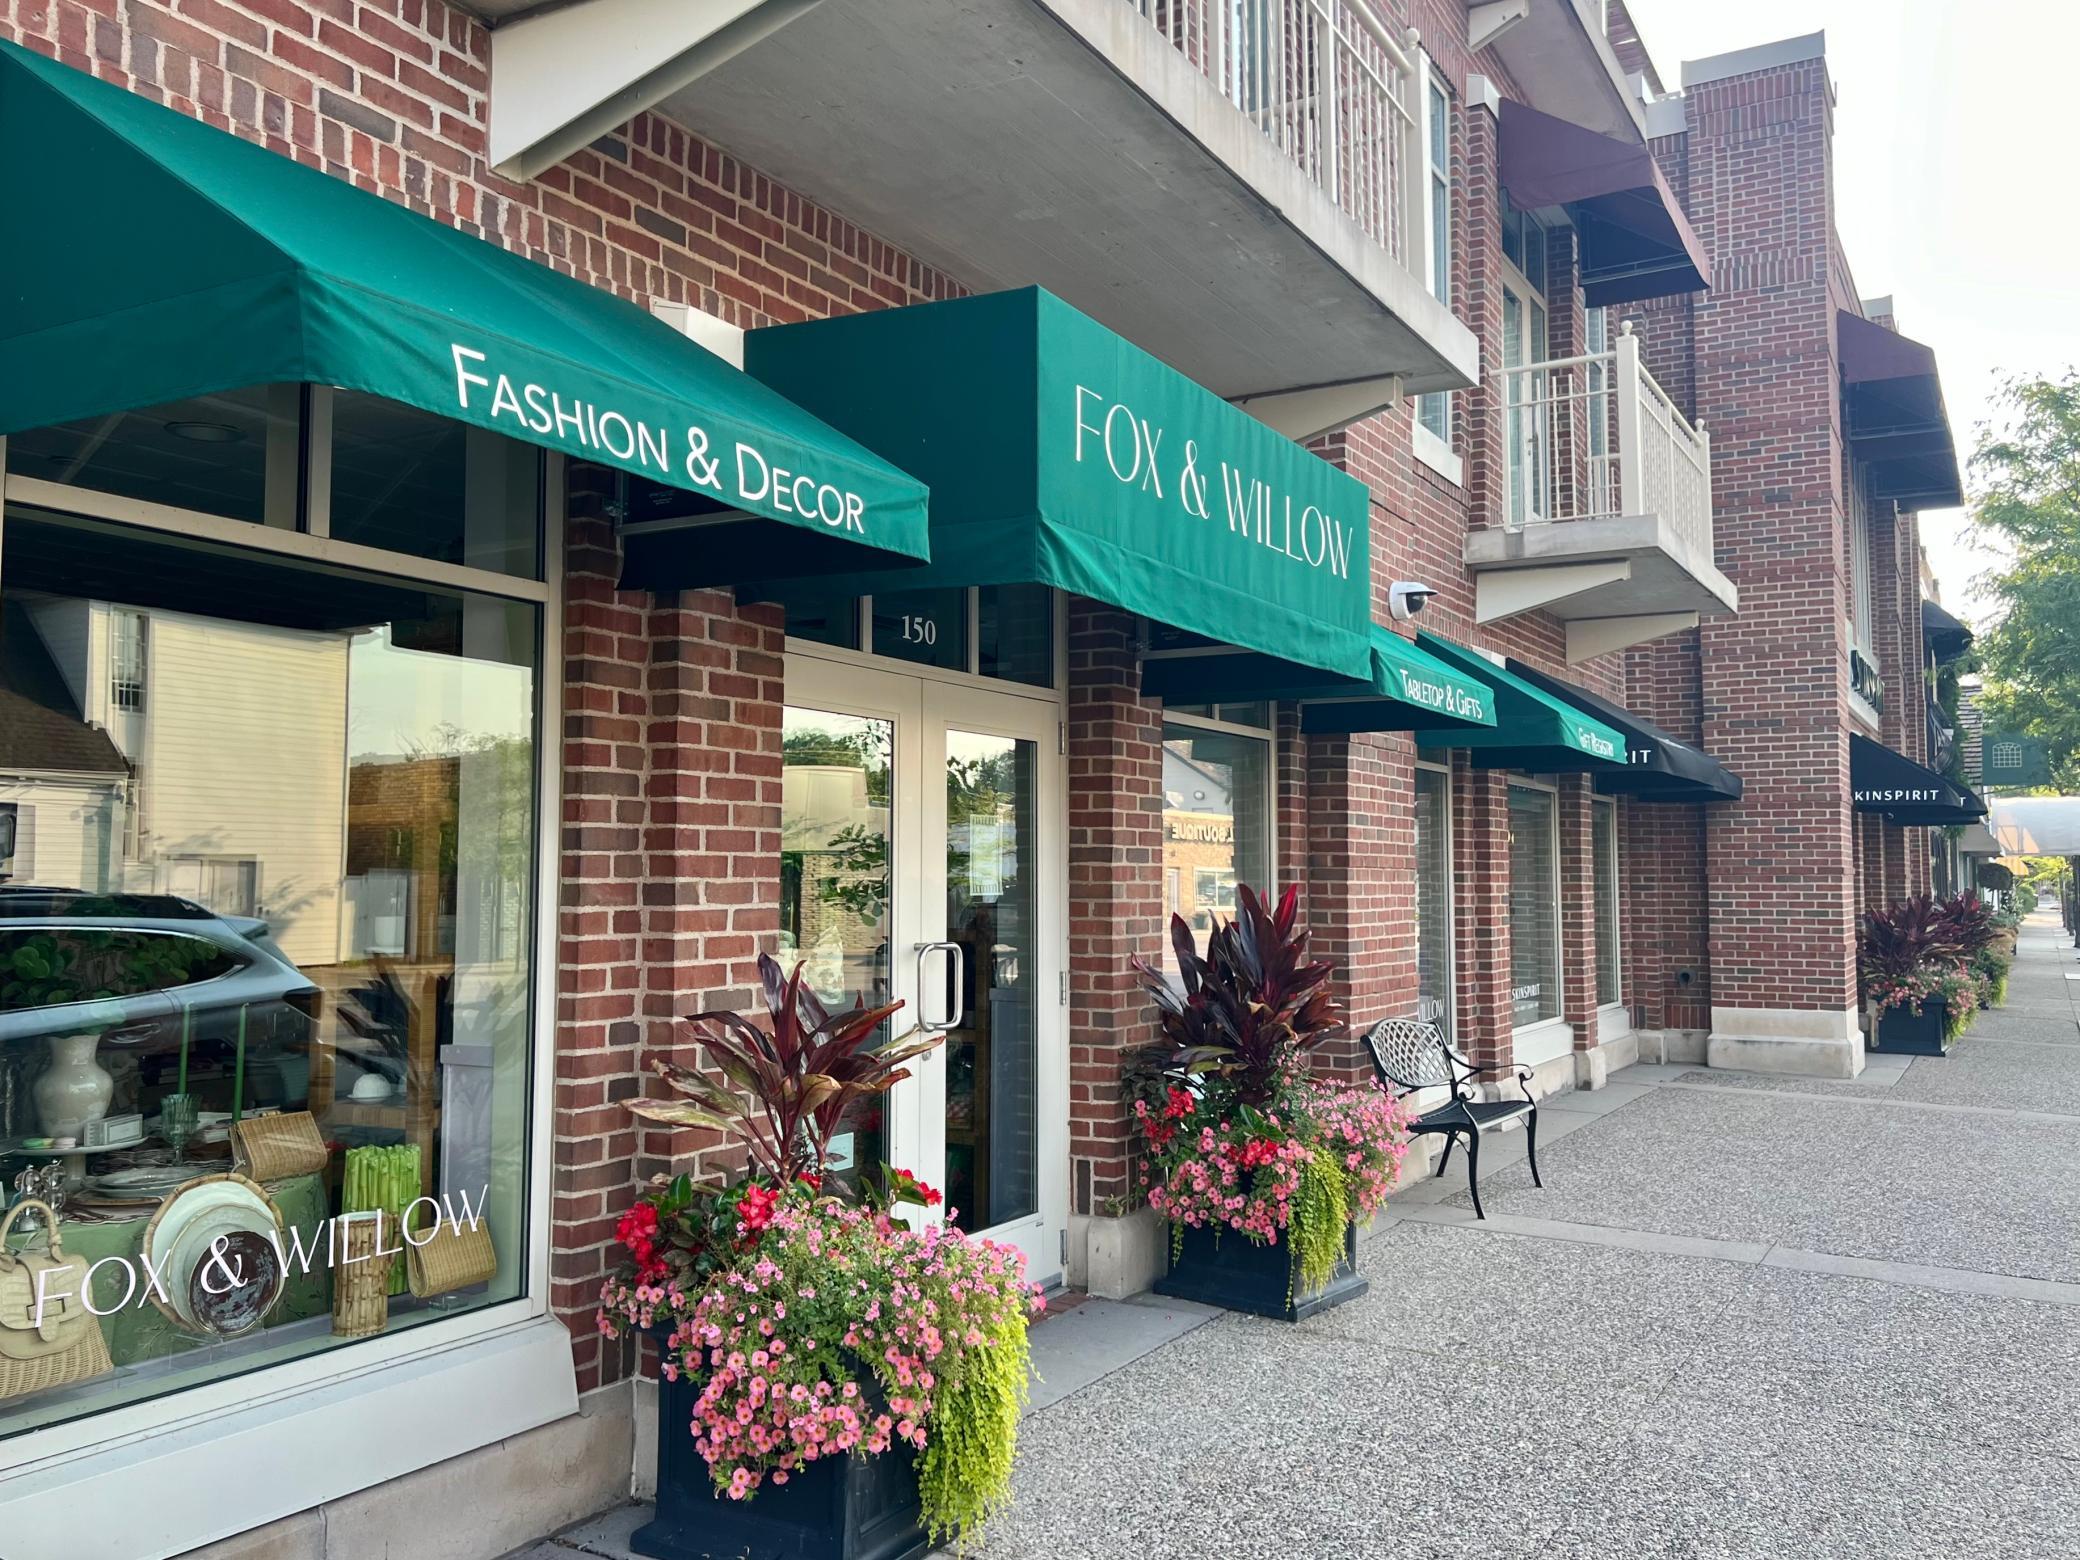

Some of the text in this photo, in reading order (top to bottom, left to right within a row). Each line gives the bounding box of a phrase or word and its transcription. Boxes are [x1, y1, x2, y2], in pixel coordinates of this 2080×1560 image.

[451, 343, 864, 534] FASHION & DECOR
[1076, 384, 1353, 579] FOX & WILLOW
[902, 615, 936, 645] 150
[1400, 668, 1483, 719] TABLETOP & GIFTS
[1625, 749, 1652, 764] IT
[35, 1184, 488, 1328] FOX & WILLOW
